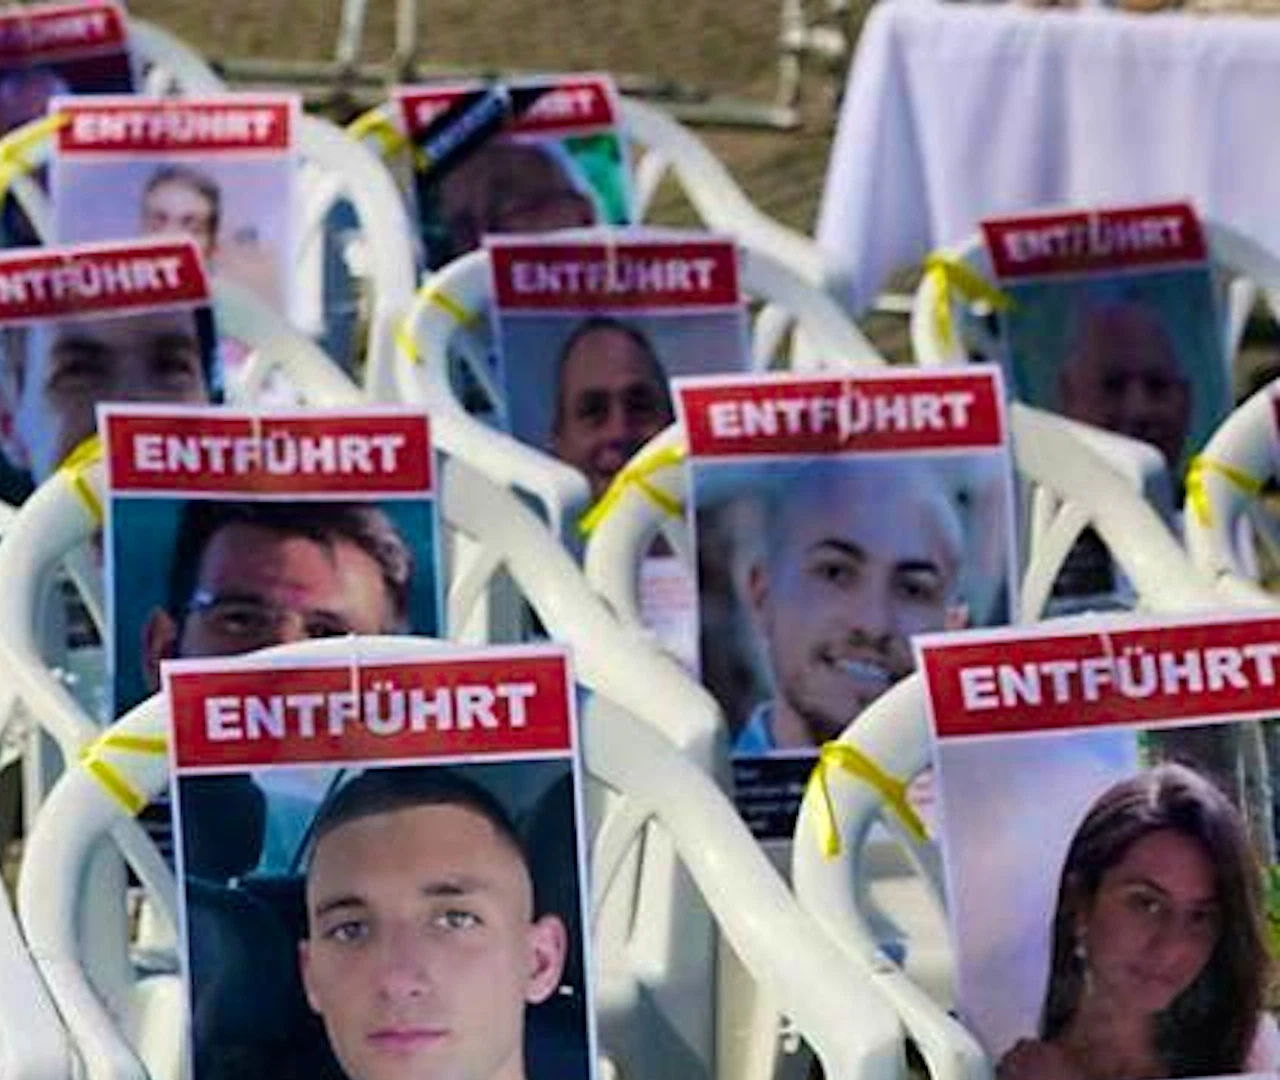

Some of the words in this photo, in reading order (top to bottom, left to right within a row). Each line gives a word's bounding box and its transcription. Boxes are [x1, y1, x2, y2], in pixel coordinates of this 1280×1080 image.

[708, 388, 974, 438] ENTFÜHRT
[133, 431, 405, 474] ENTFÜHRT
[959, 641, 1280, 711] ENTFÜHRT
[205, 682, 536, 742] ENTFÜHRT
